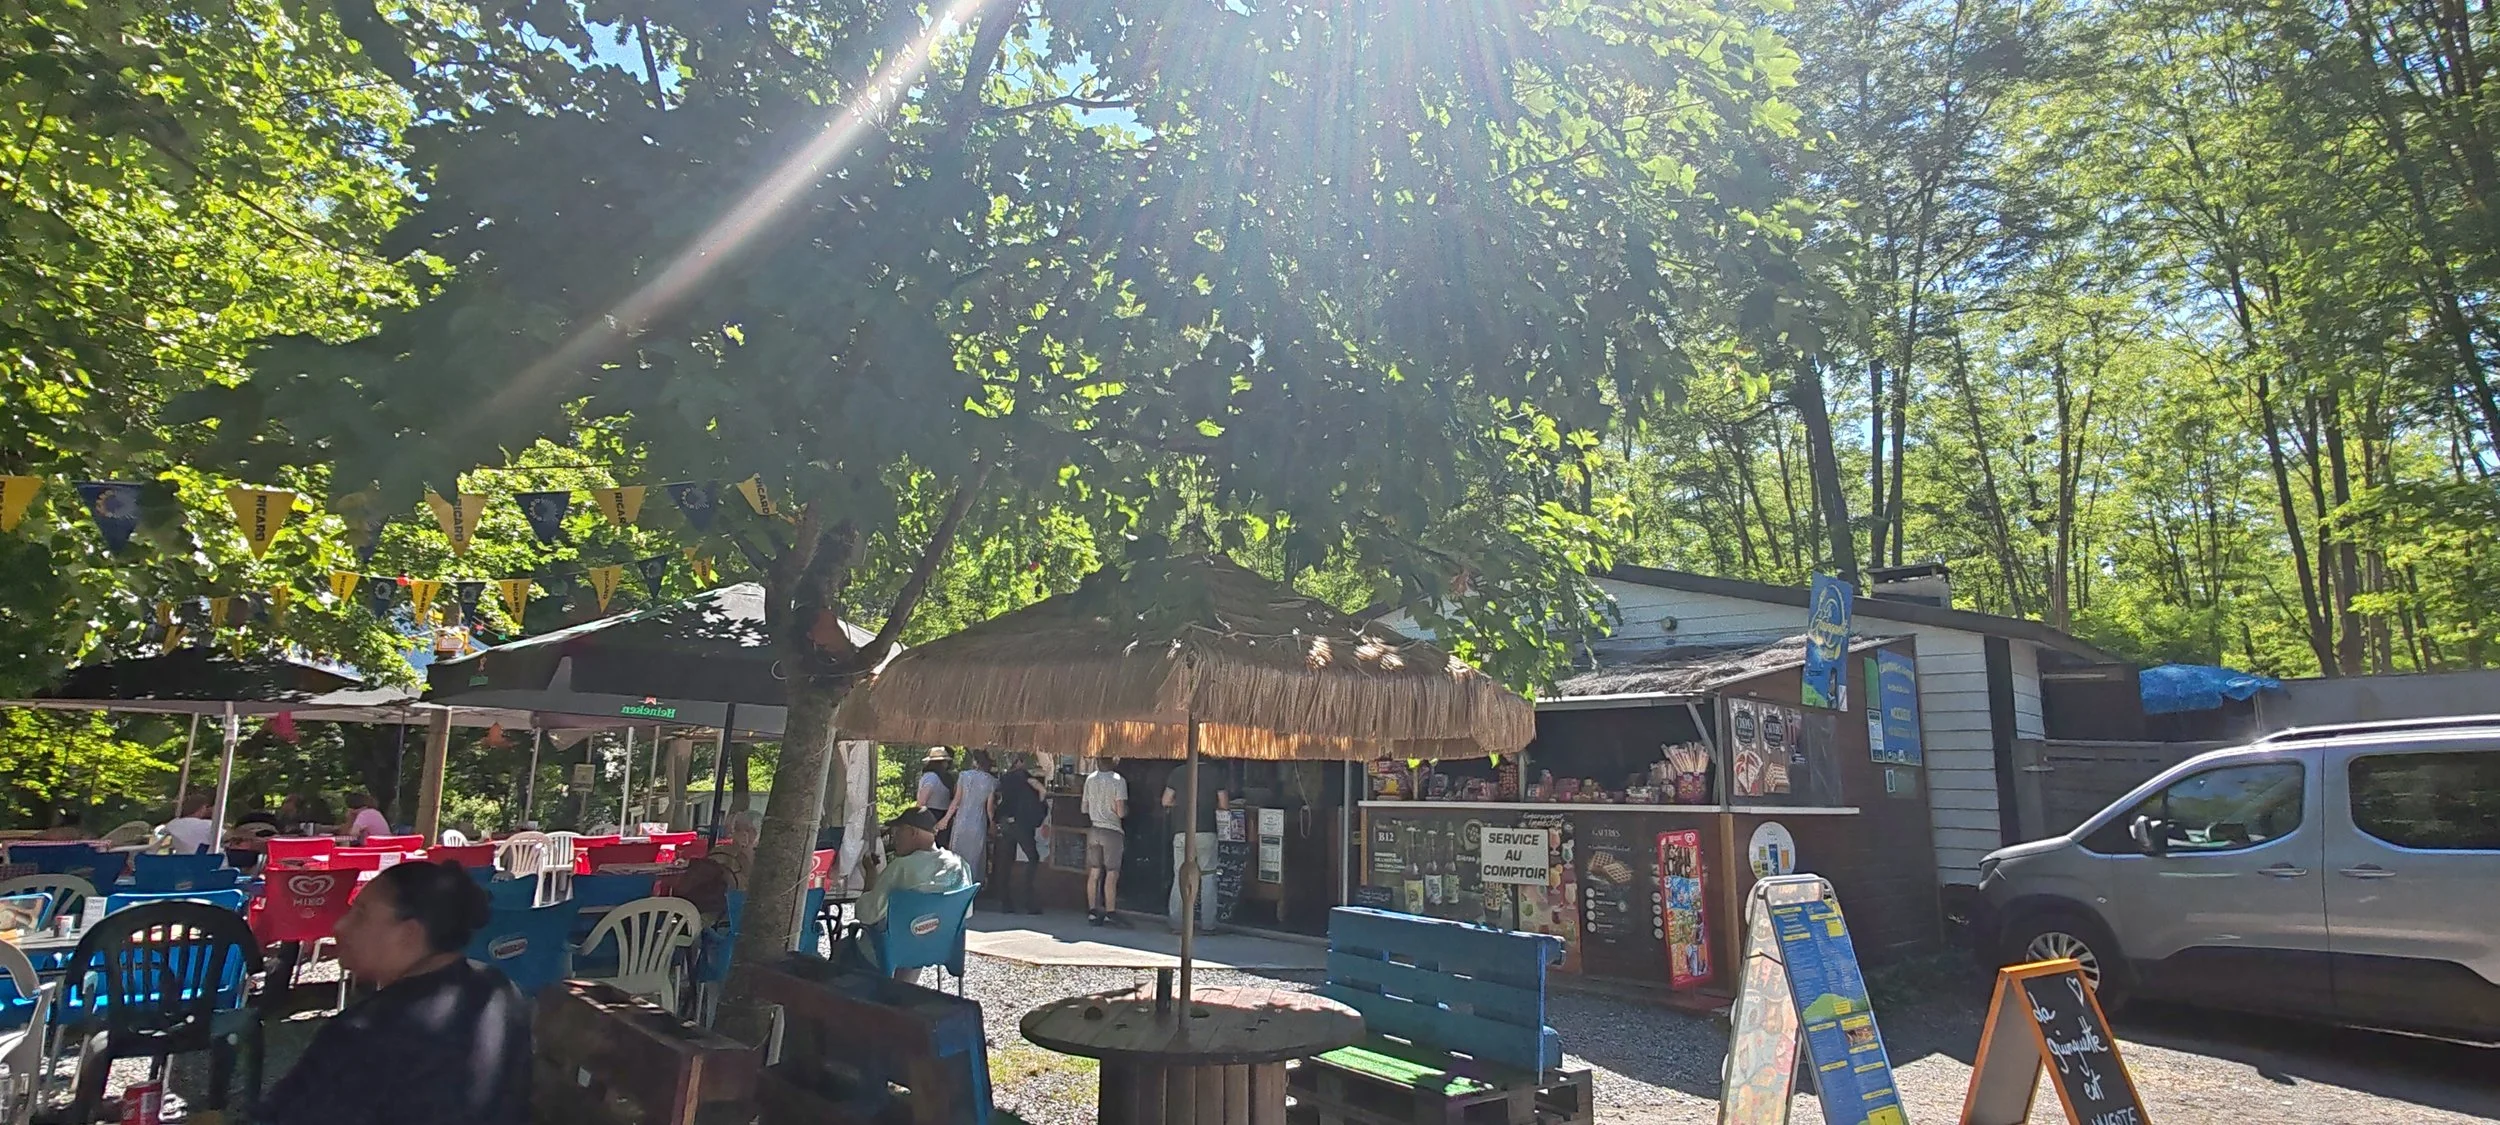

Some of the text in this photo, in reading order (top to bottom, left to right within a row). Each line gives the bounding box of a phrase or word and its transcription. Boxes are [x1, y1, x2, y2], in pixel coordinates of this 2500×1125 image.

[255, 495, 267, 541] RICARD
[1378, 831, 1394, 842] B12
[1488, 832, 1541, 846] SERVICE
[1504, 849, 1523, 861] AU
[1482, 864, 1547, 880] COMPTOIR
